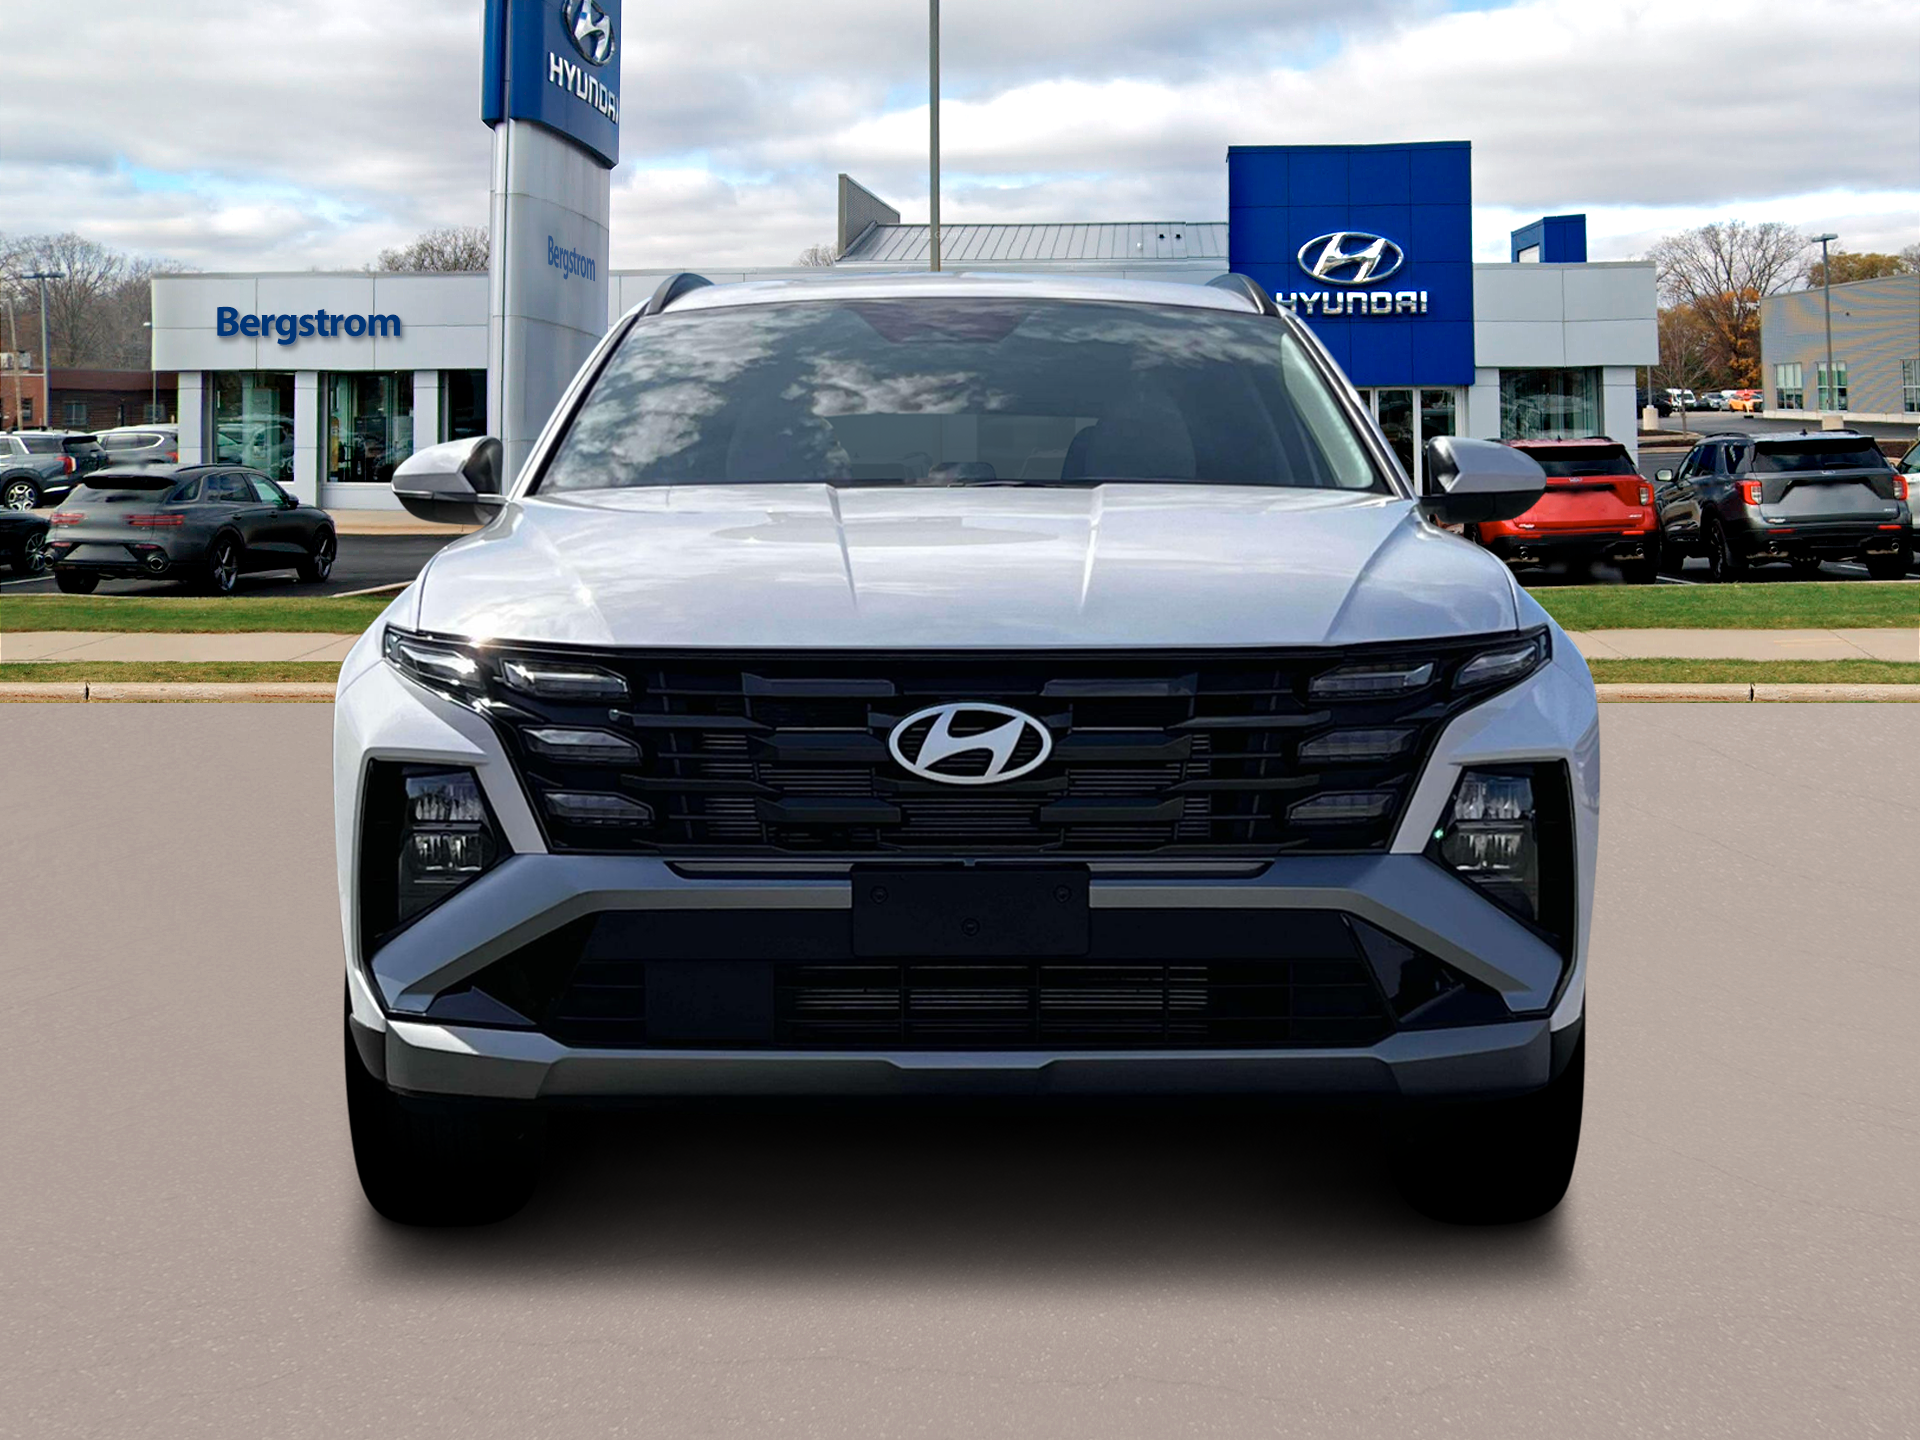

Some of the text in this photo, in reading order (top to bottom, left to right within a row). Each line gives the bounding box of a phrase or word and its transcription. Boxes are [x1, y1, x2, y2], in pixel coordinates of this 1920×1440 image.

[549, 51, 619, 124] HYUNDAI
[547, 235, 596, 282] Bergstrom
[1275, 290, 1428, 315] HYUNDAI
[216, 306, 402, 346] Bergstrom
